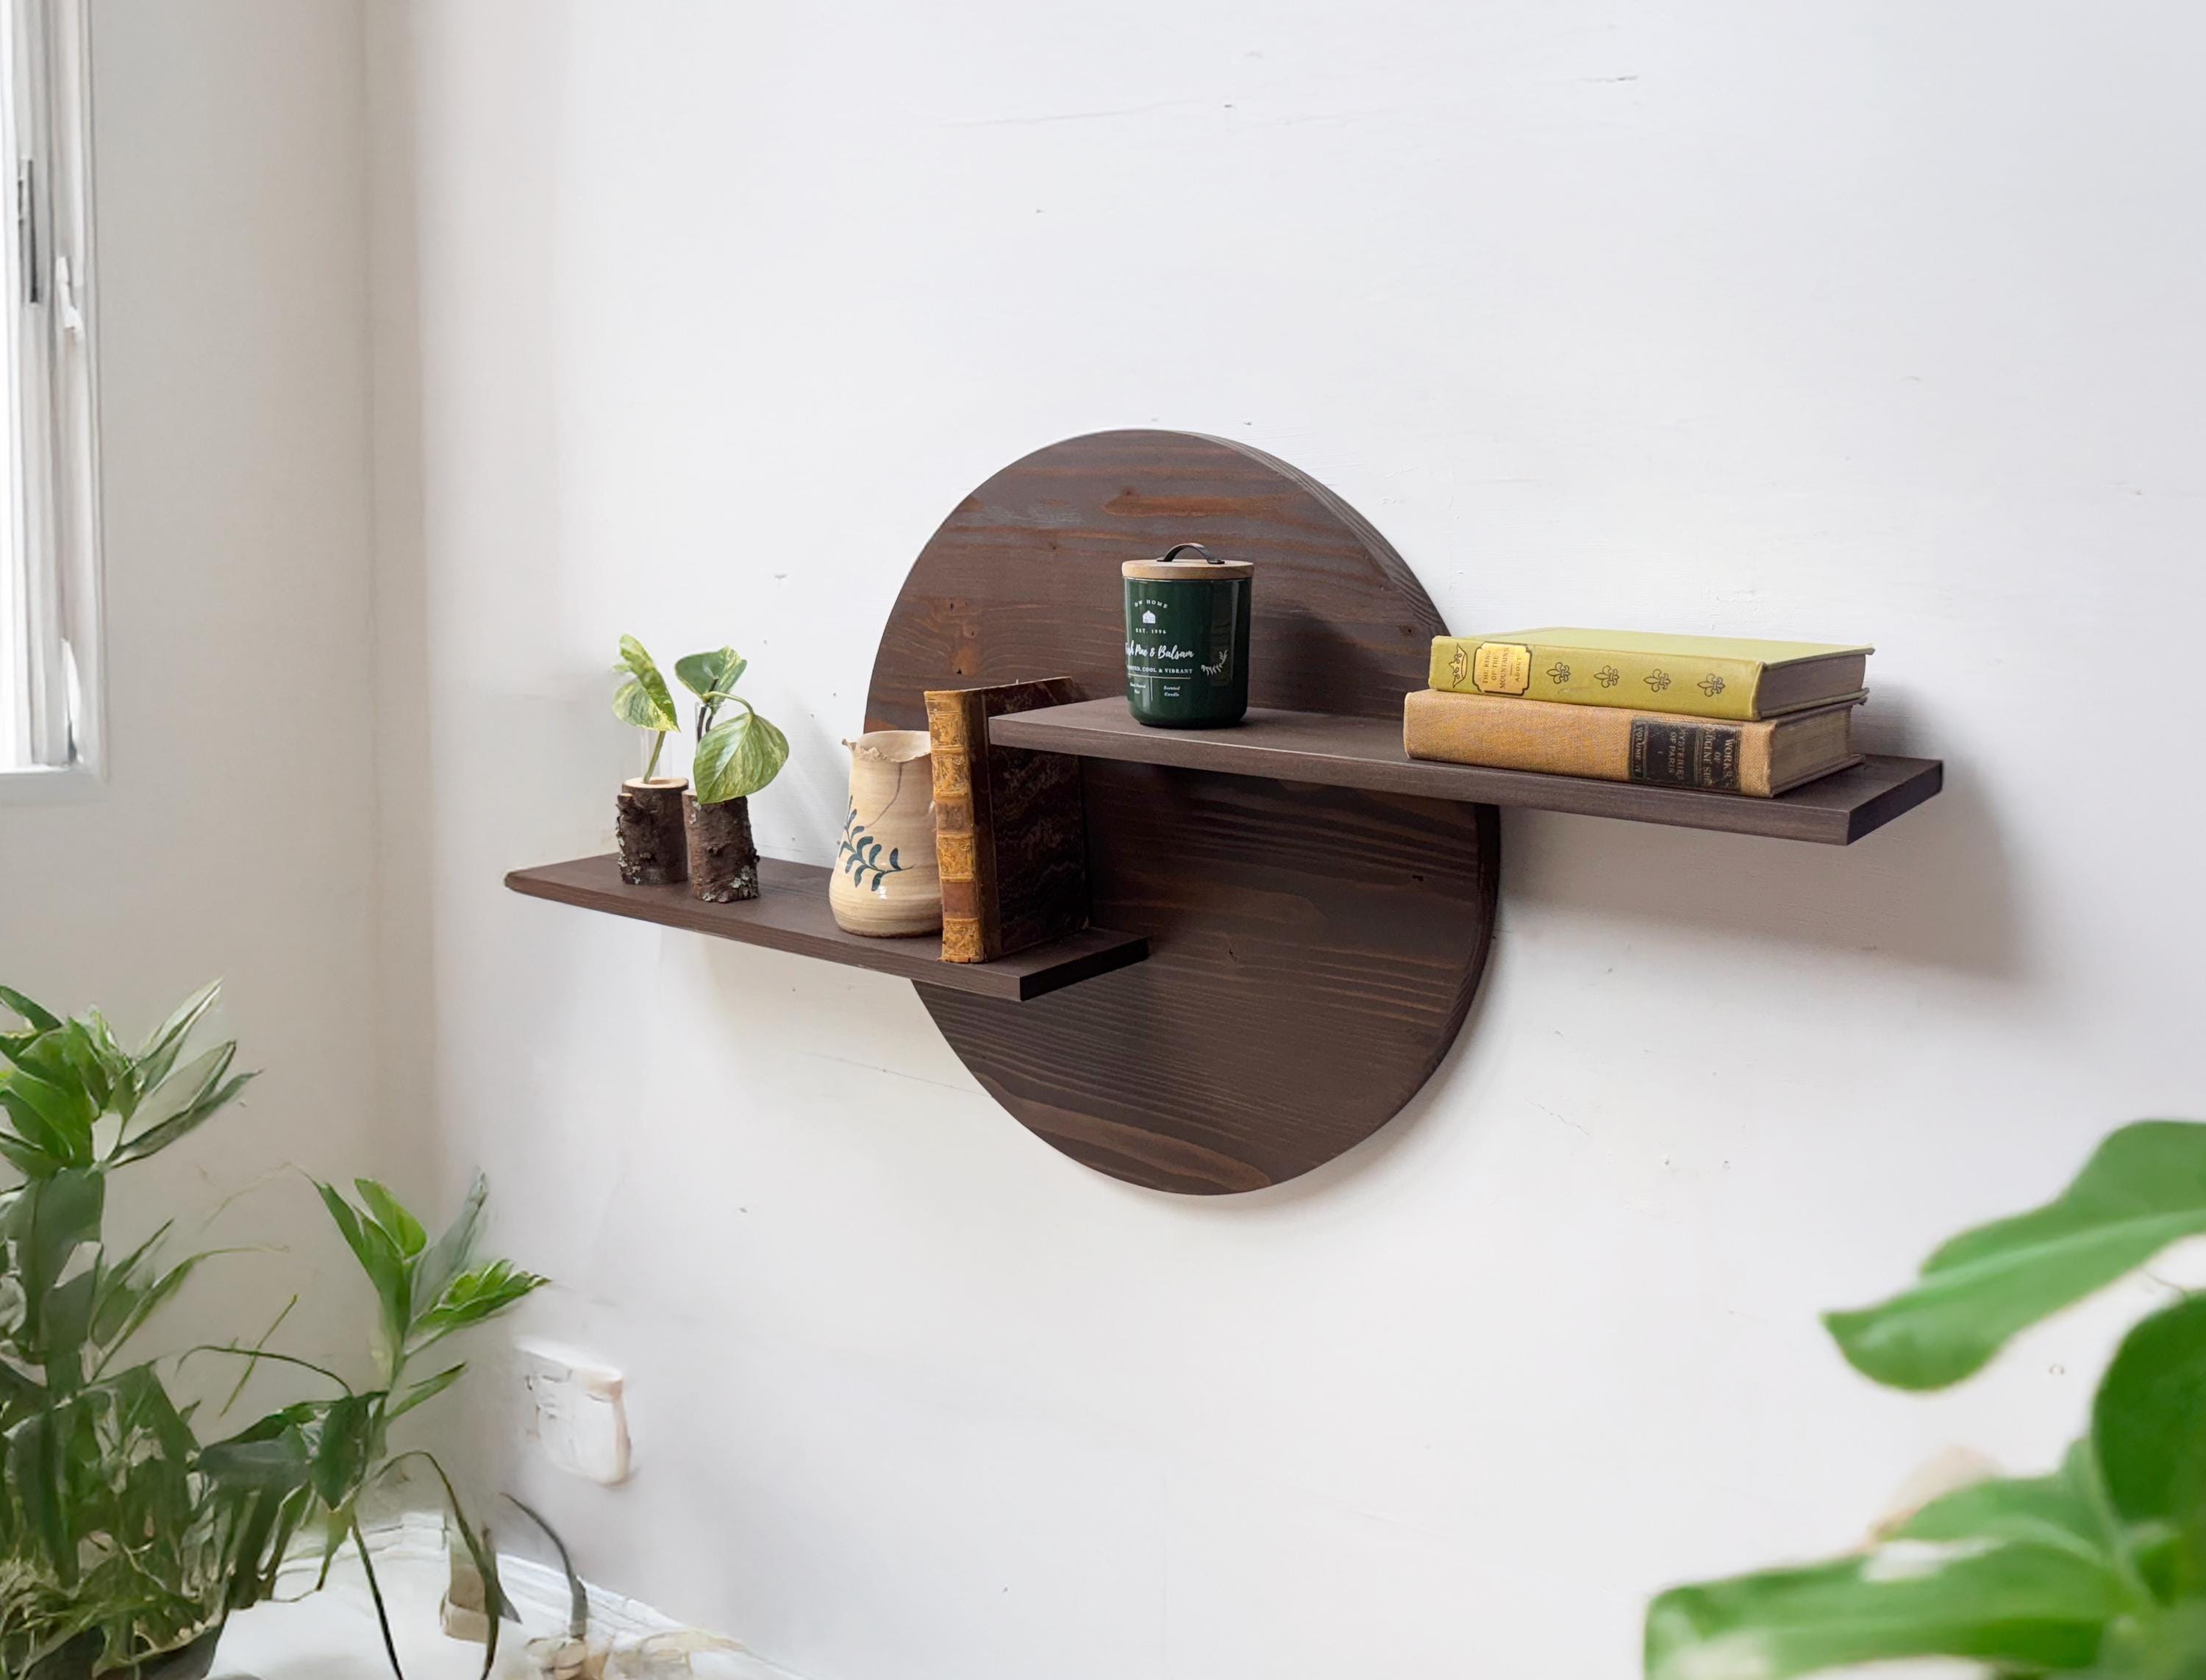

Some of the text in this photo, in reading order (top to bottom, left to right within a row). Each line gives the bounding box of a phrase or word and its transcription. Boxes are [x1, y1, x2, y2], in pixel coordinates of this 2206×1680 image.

[1146, 599, 1168, 609] HOME
[1149, 647, 1155, 657] &
[1157, 645, 1194, 660] Balsam
[1483, 650, 1491, 668] KING
[1491, 670, 1497, 681] OF
[1500, 646, 1510, 690] MOUNTAINS
[1634, 726, 1643, 761] VOLUME
[1668, 731, 1677, 773] OF PARIS
[1676, 728, 1686, 781] MYSTERIES
[1713, 751, 1721, 764] OF
